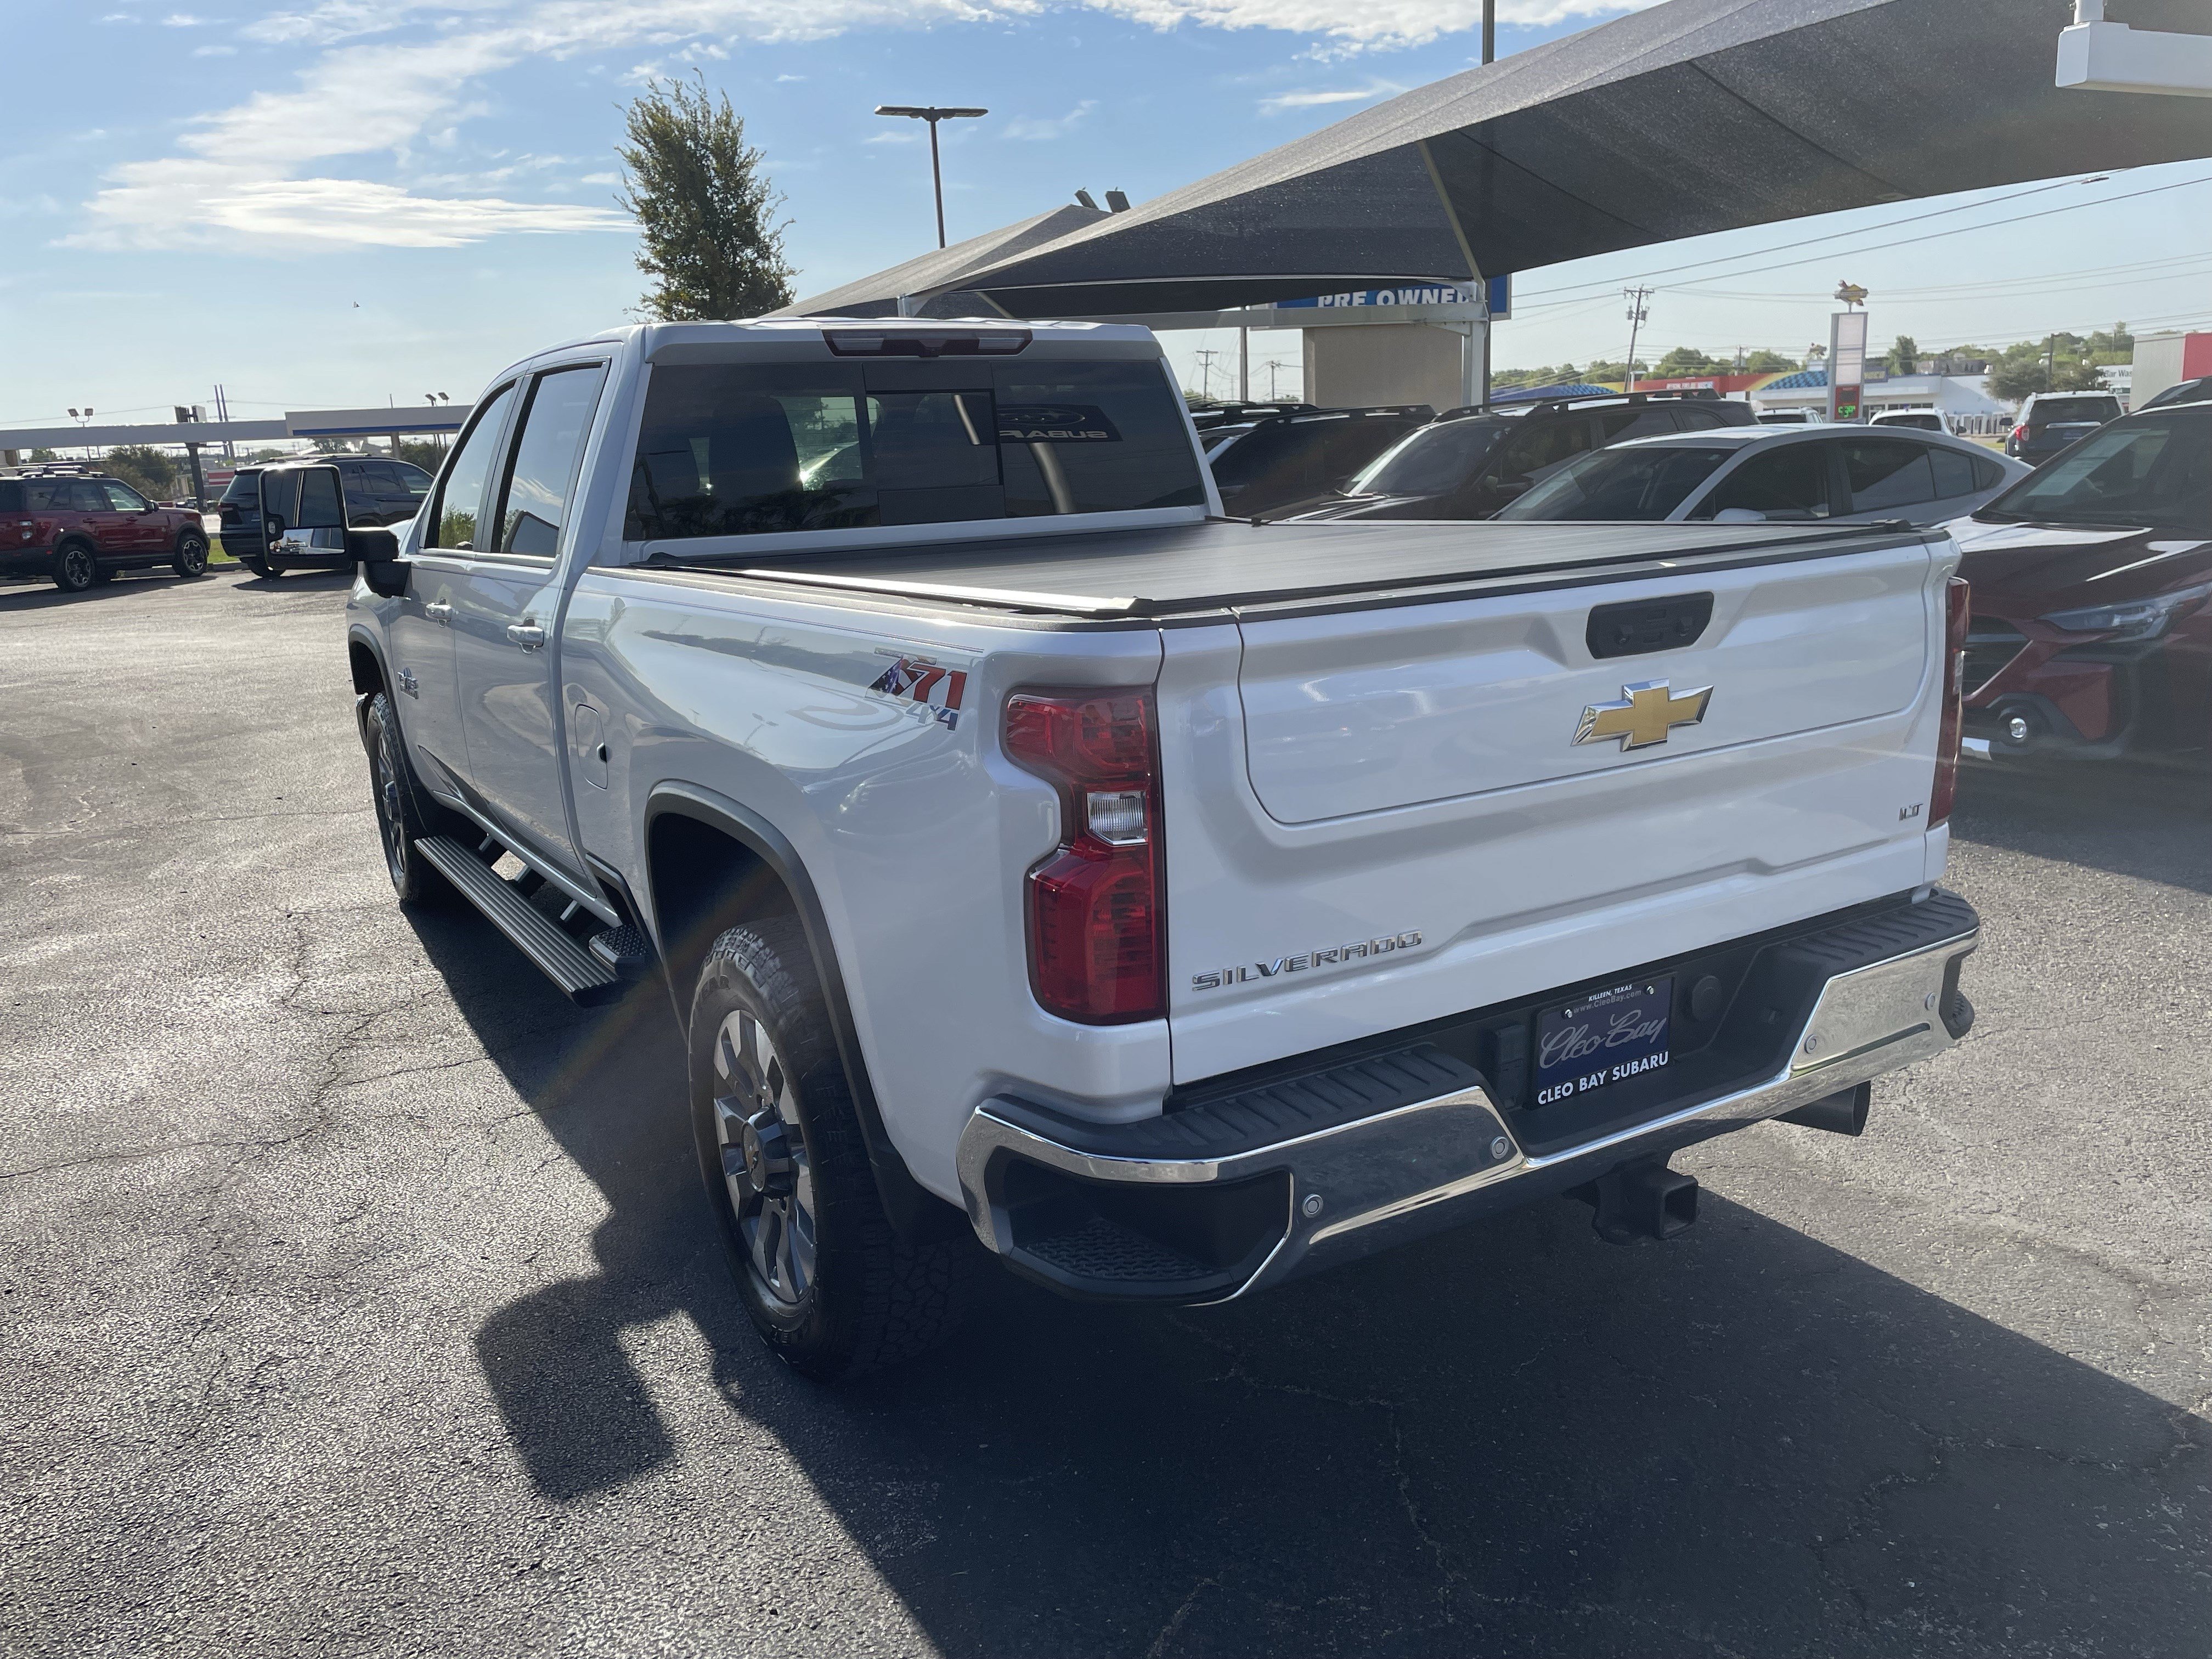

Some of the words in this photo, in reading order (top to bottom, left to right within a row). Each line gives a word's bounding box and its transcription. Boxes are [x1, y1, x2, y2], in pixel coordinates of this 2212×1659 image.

[1318, 291, 1367, 307] PRE
[1899, 803, 1923, 821] LT
[1192, 929, 1422, 991] SILVERADO
[1614, 984, 1632, 995] TEXAS
[1573, 990, 1641, 1013] www.CleoBay.com
[1539, 1024, 1606, 1069] Cleo
[1605, 1009, 1667, 1048] Bay
[1538, 1082, 1573, 1104] CLEO
[1579, 1070, 1607, 1091] BAY
[1612, 1051, 1668, 1080] SUBARU
